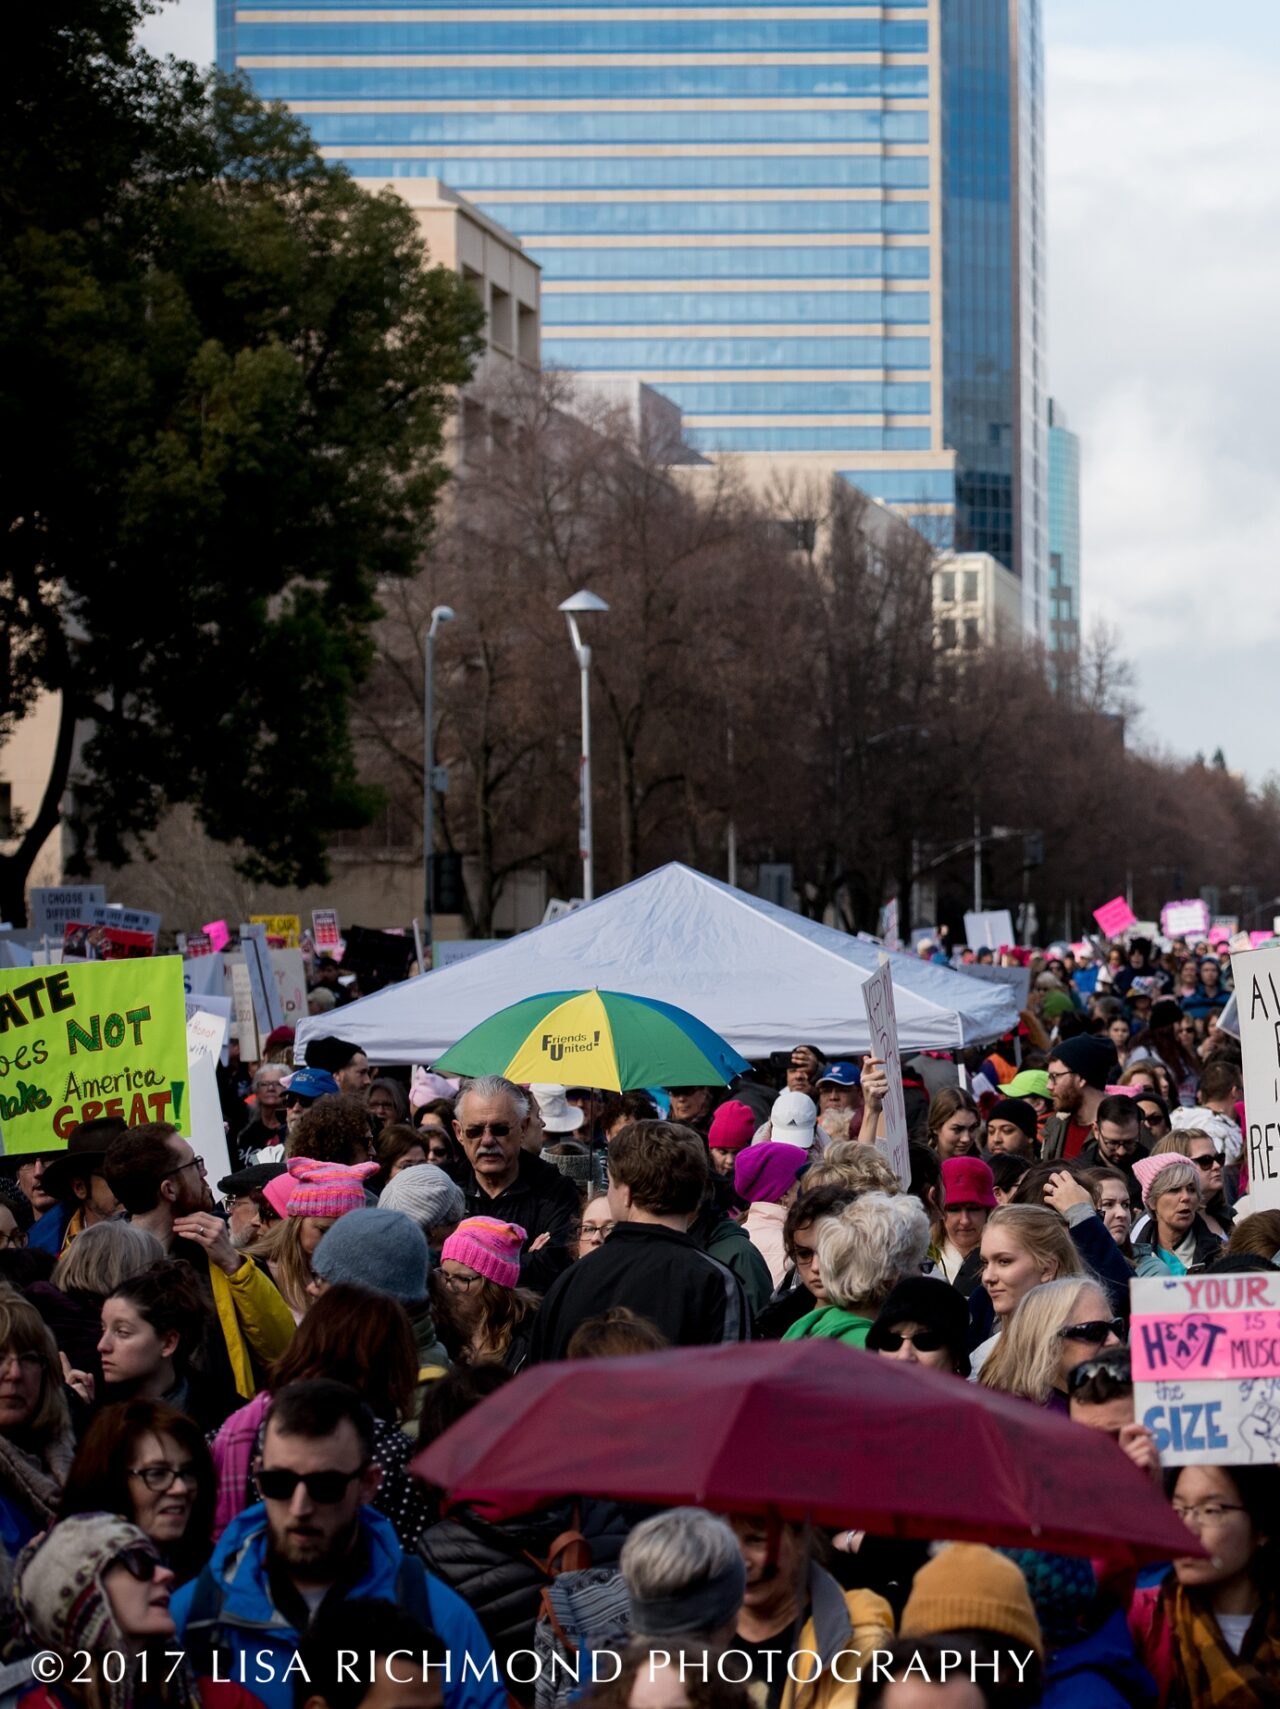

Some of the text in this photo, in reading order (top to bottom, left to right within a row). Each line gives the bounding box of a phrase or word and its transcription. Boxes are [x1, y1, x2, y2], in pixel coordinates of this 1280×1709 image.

[1251, 974, 1269, 1020] A
[66, 1005, 152, 1055] NOT
[542, 1034, 587, 1051] Friends
[64, 1066, 166, 1103] America
[1141, 1322, 1227, 1370] HEART
[1155, 1381, 1185, 1400] the
[1143, 1401, 1229, 1452] SIZE
